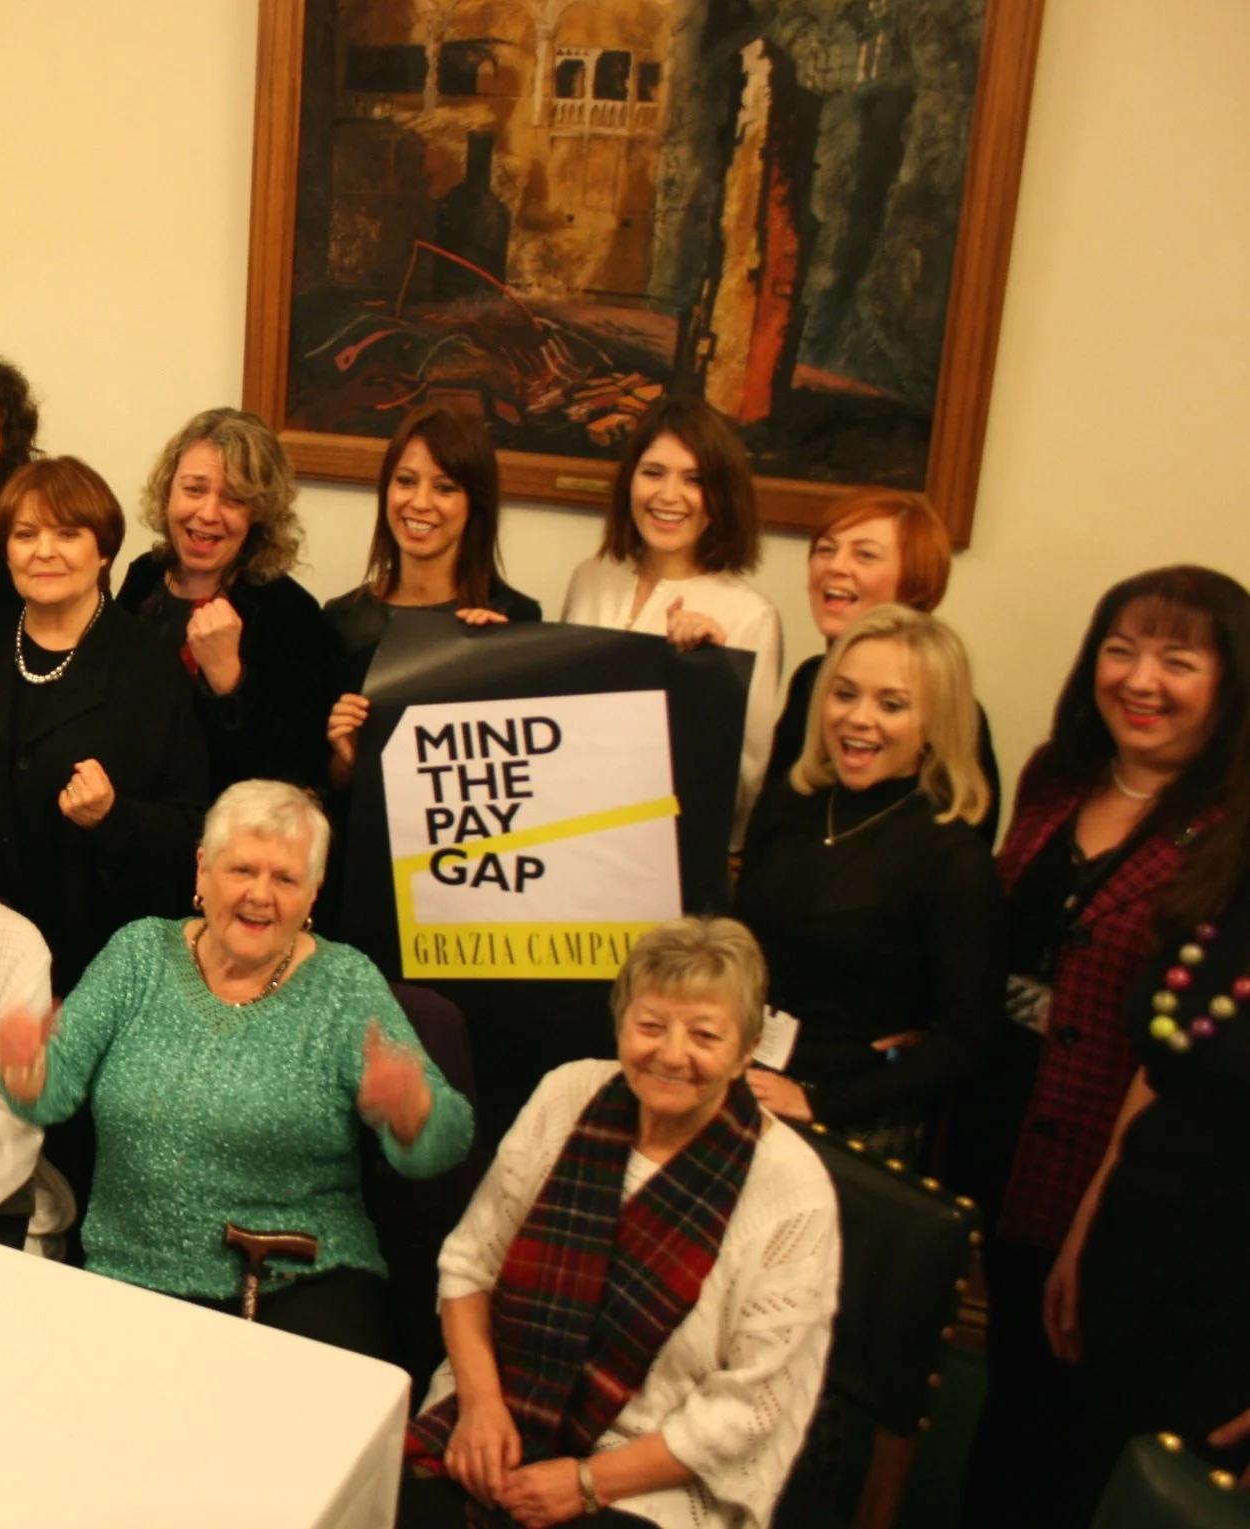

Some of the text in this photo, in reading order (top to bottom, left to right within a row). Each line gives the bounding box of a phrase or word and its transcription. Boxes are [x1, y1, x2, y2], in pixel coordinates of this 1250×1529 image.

[414, 715, 562, 763] MIND
[416, 759, 534, 803] THE
[424, 802, 522, 845] PAY
[428, 847, 546, 894] GAP
[413, 931, 643, 966] GRAZIA CAMPAI
